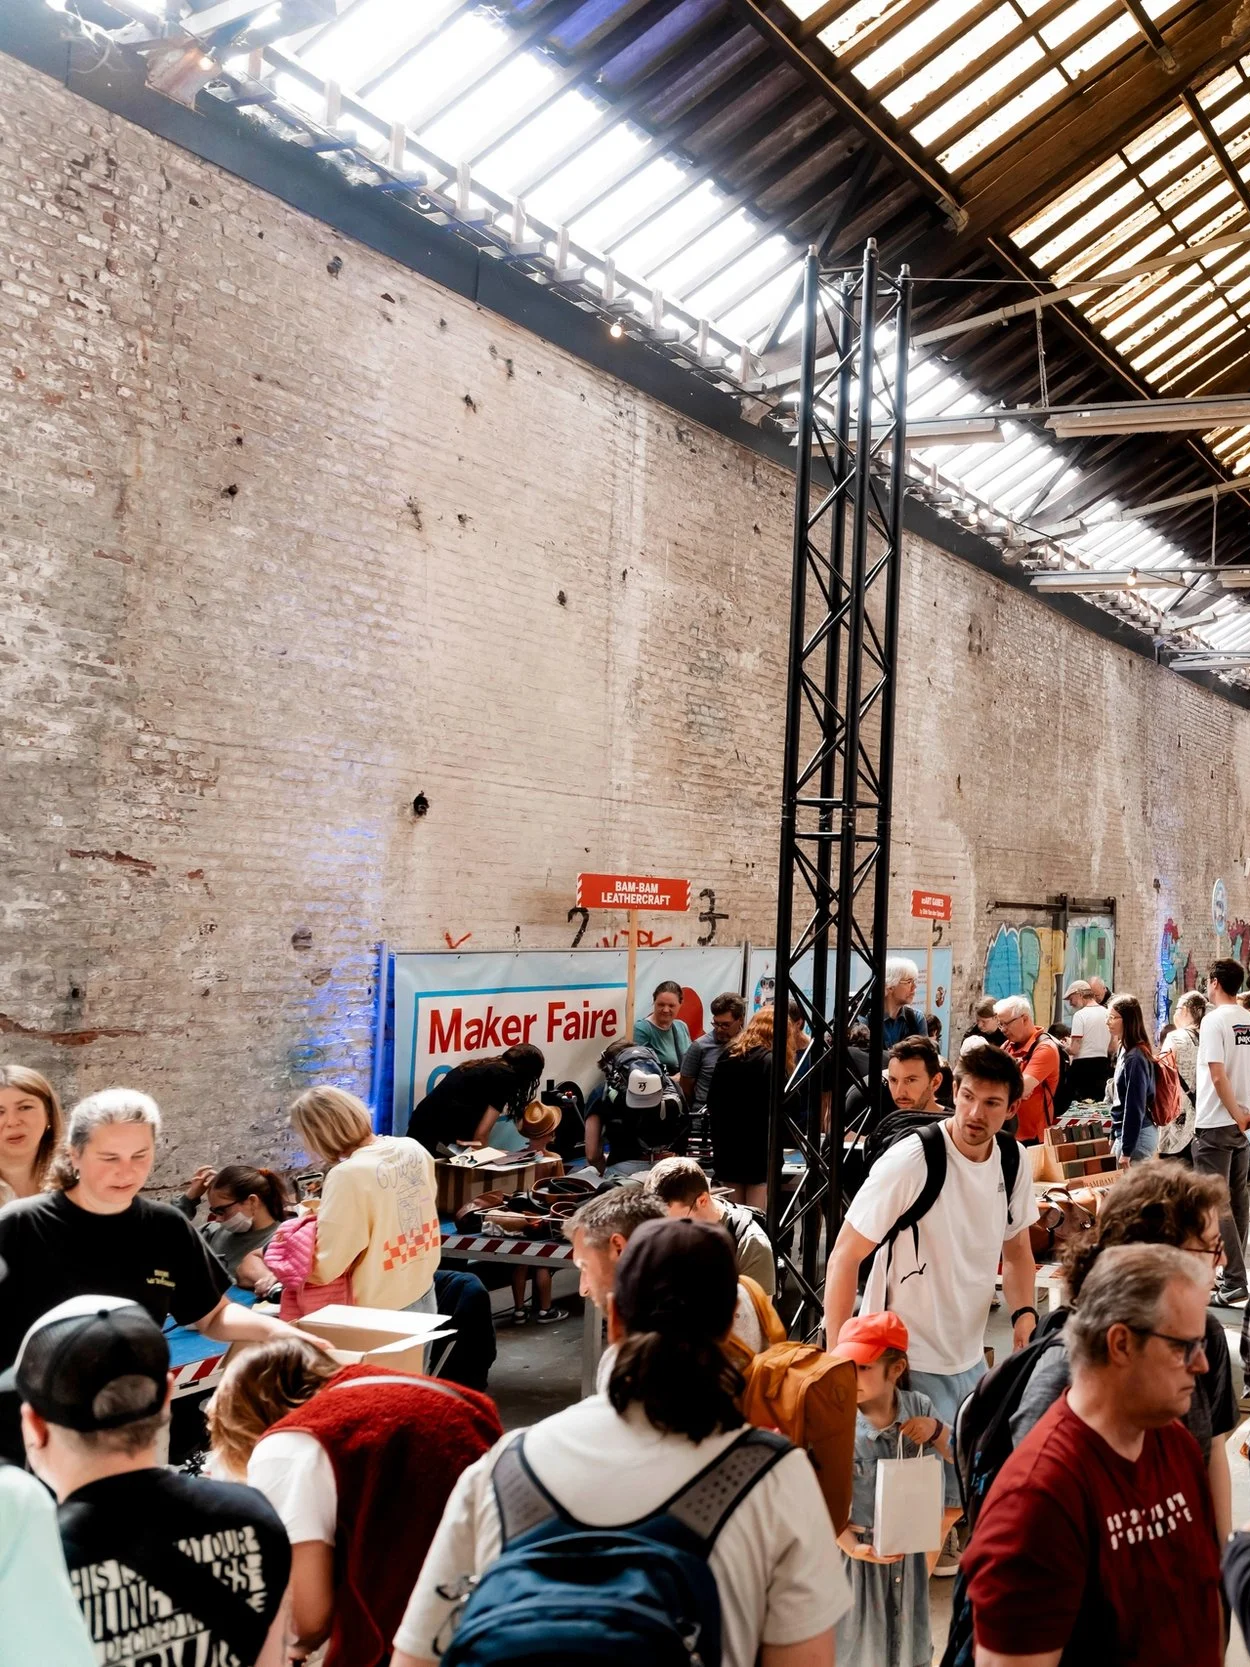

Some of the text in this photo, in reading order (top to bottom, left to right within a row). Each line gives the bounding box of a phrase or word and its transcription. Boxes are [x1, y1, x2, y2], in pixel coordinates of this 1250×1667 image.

[614, 880, 659, 895] BAM-BAM
[601, 891, 671, 907] LEATHERCRAFT
[428, 1000, 619, 1055] Maker Faire
